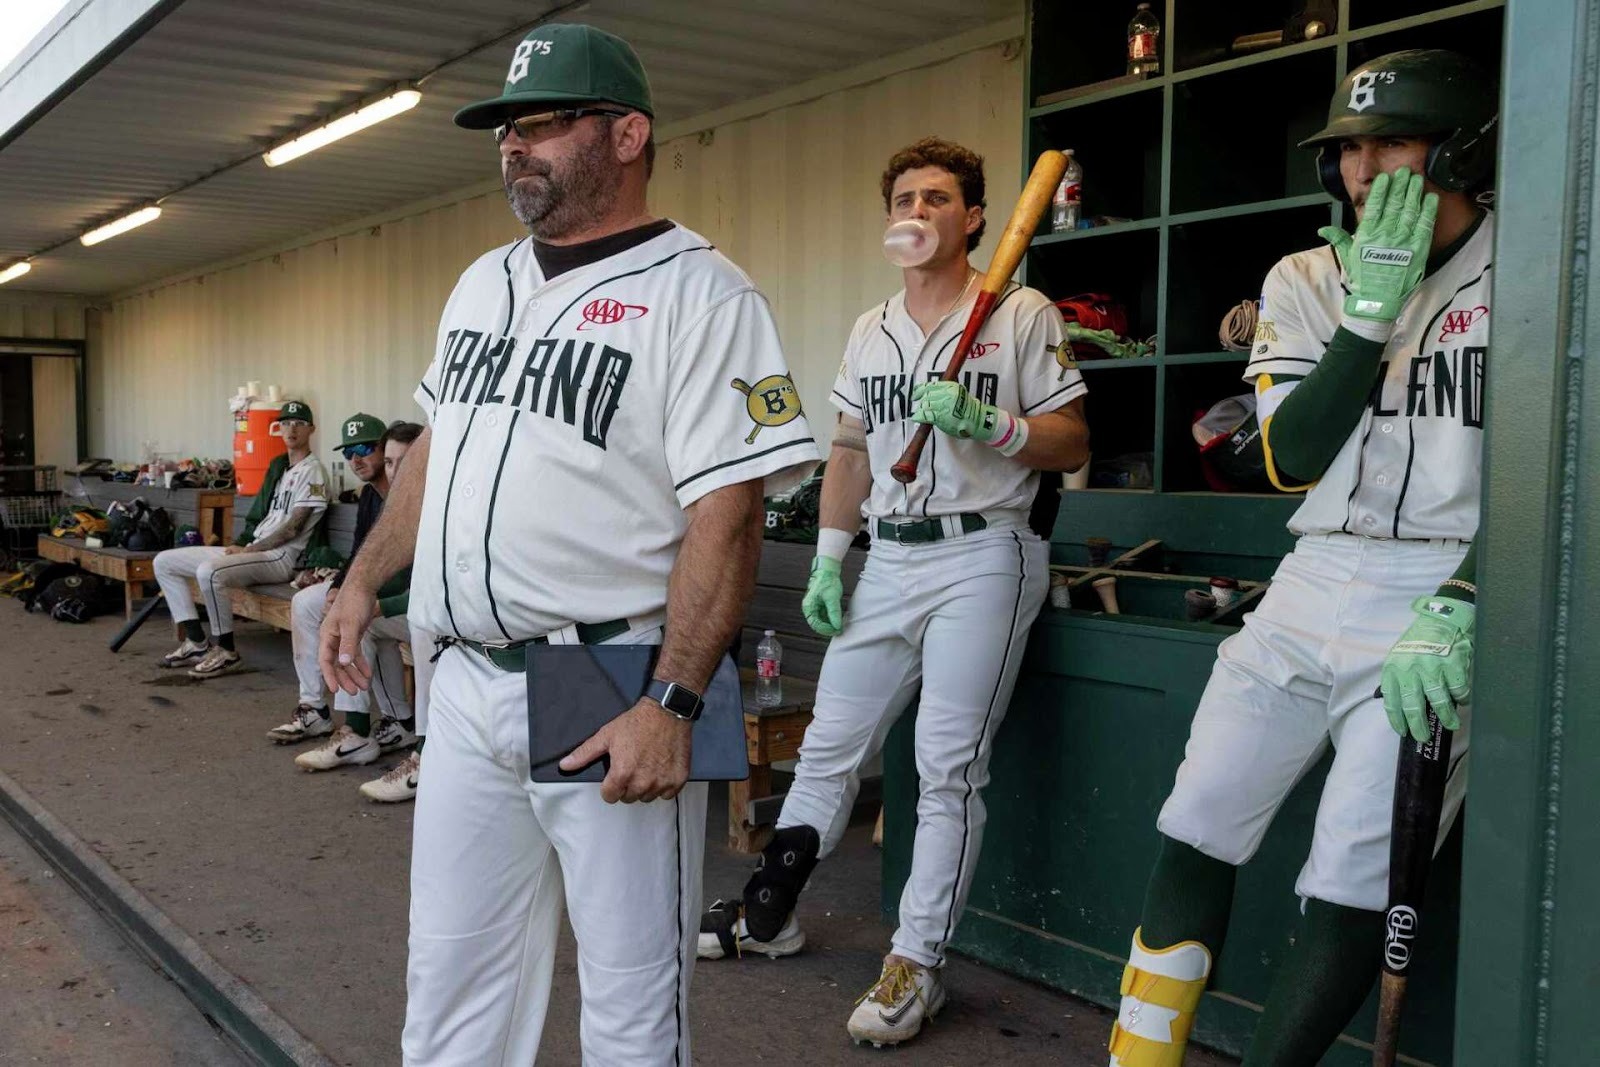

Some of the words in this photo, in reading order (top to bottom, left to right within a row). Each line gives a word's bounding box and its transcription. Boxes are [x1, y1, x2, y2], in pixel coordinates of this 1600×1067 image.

[439, 328, 633, 451] OAKLAND
[860, 371, 999, 435] OAKLD
[1368, 346, 1488, 430] LAND
